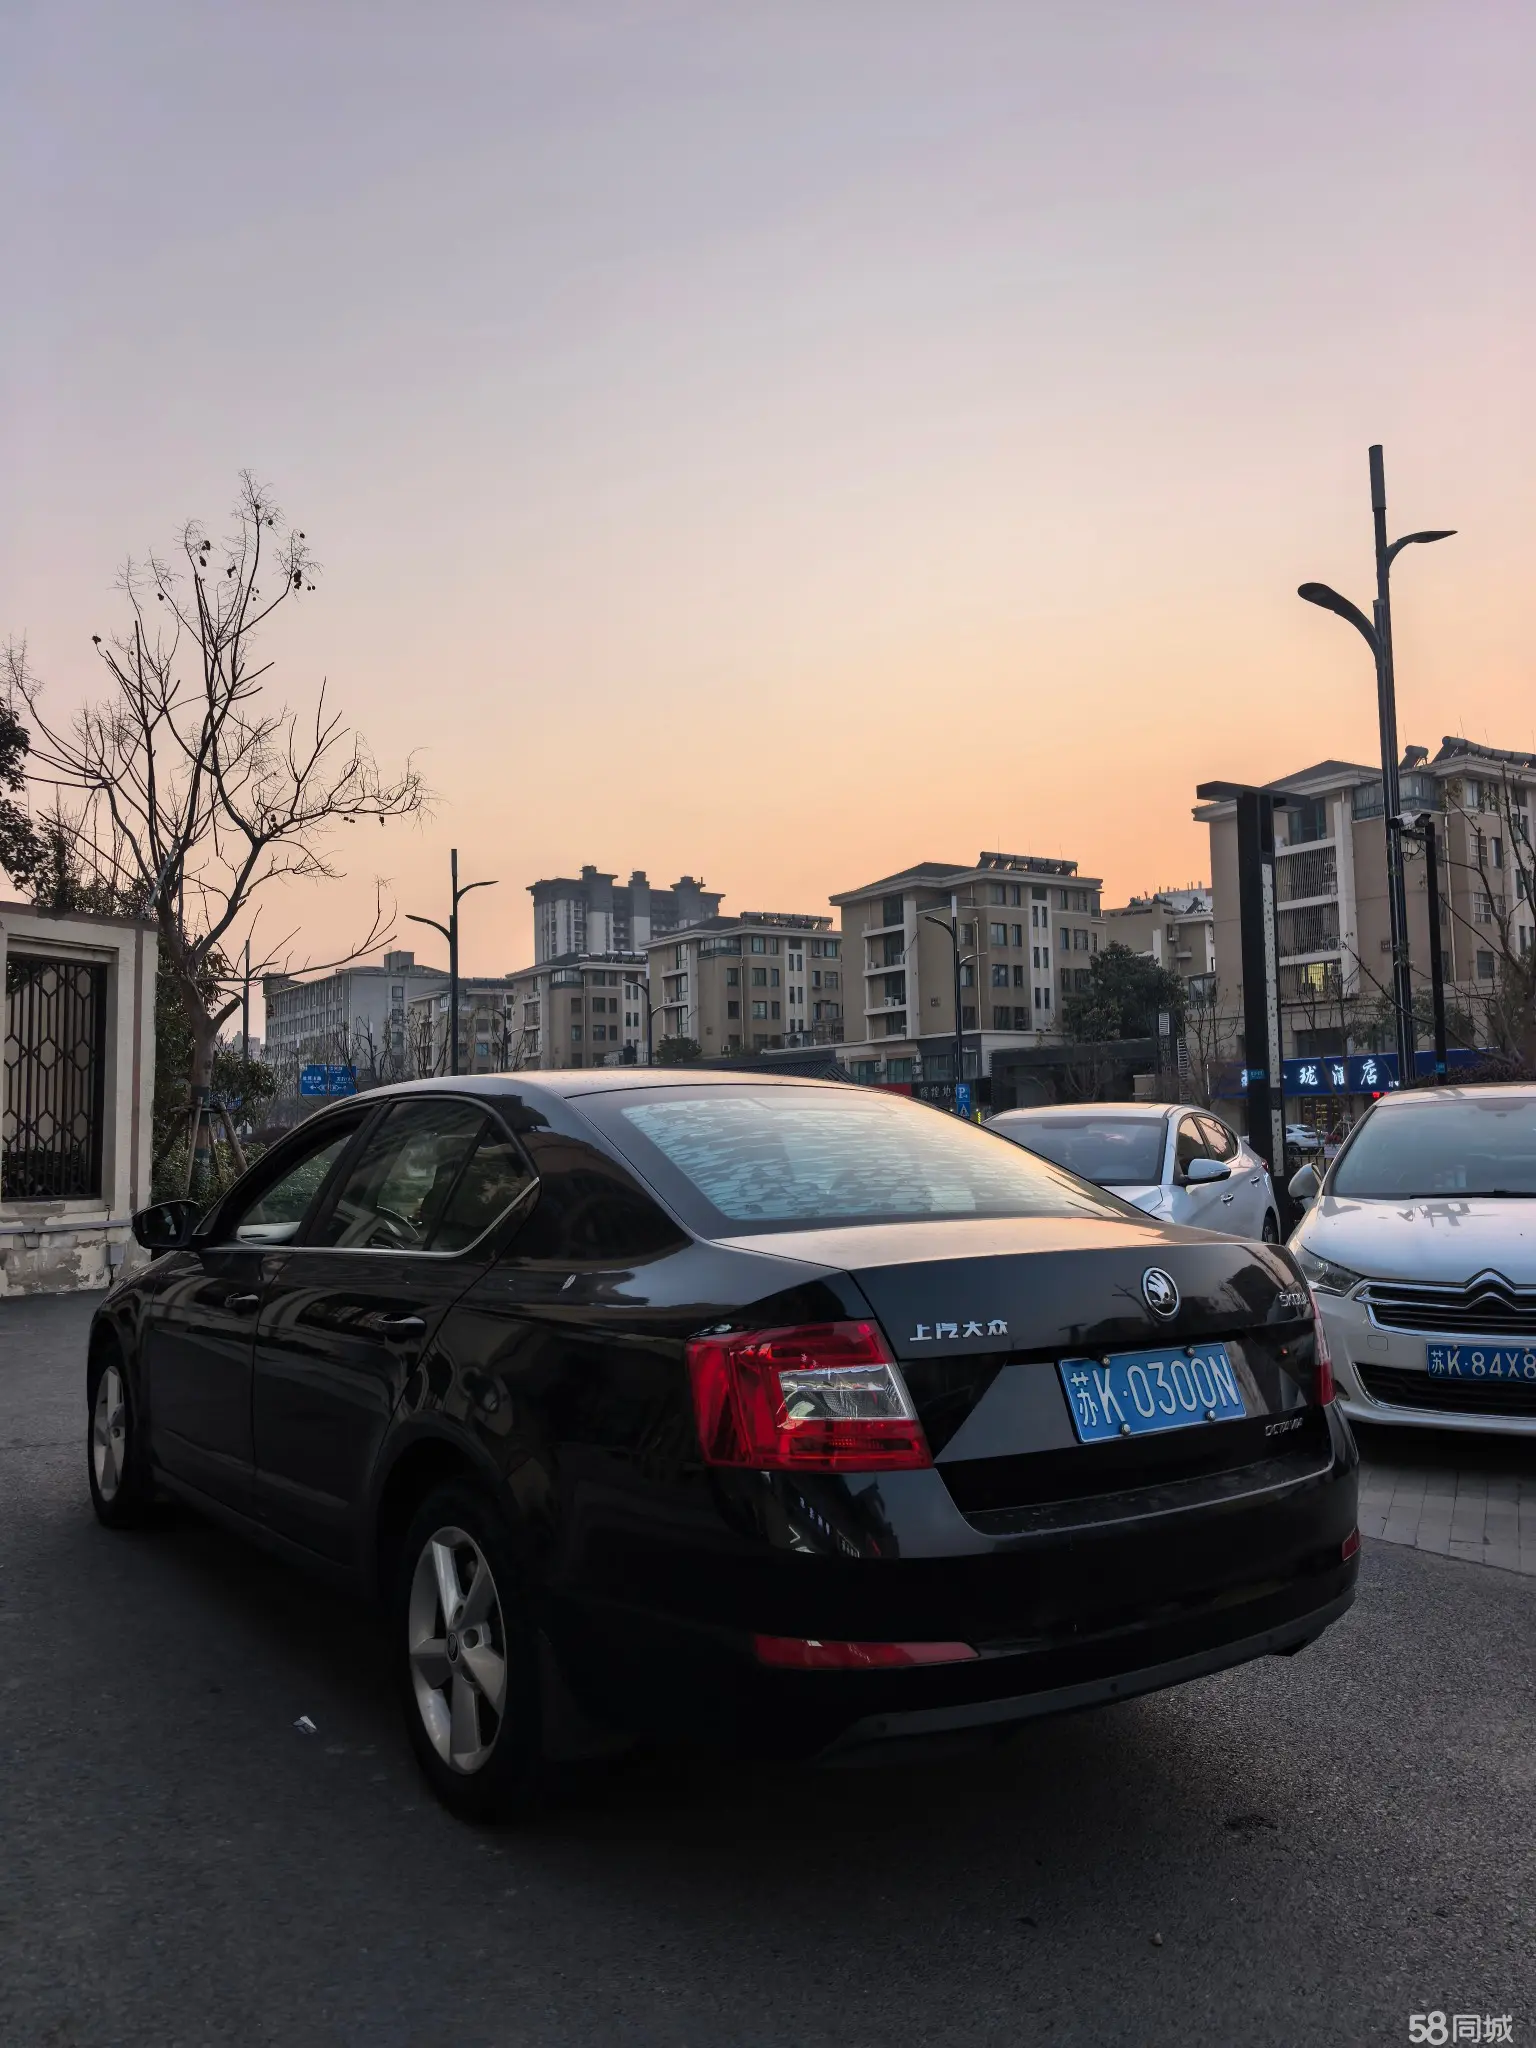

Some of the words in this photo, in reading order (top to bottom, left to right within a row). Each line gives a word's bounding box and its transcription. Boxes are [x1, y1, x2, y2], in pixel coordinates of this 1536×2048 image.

[920, 1085, 957, 1099] 辉煌地
[909, 1319, 1008, 1341] 上汽大众
[1070, 1354, 1239, 1427] 苏K·0300N
